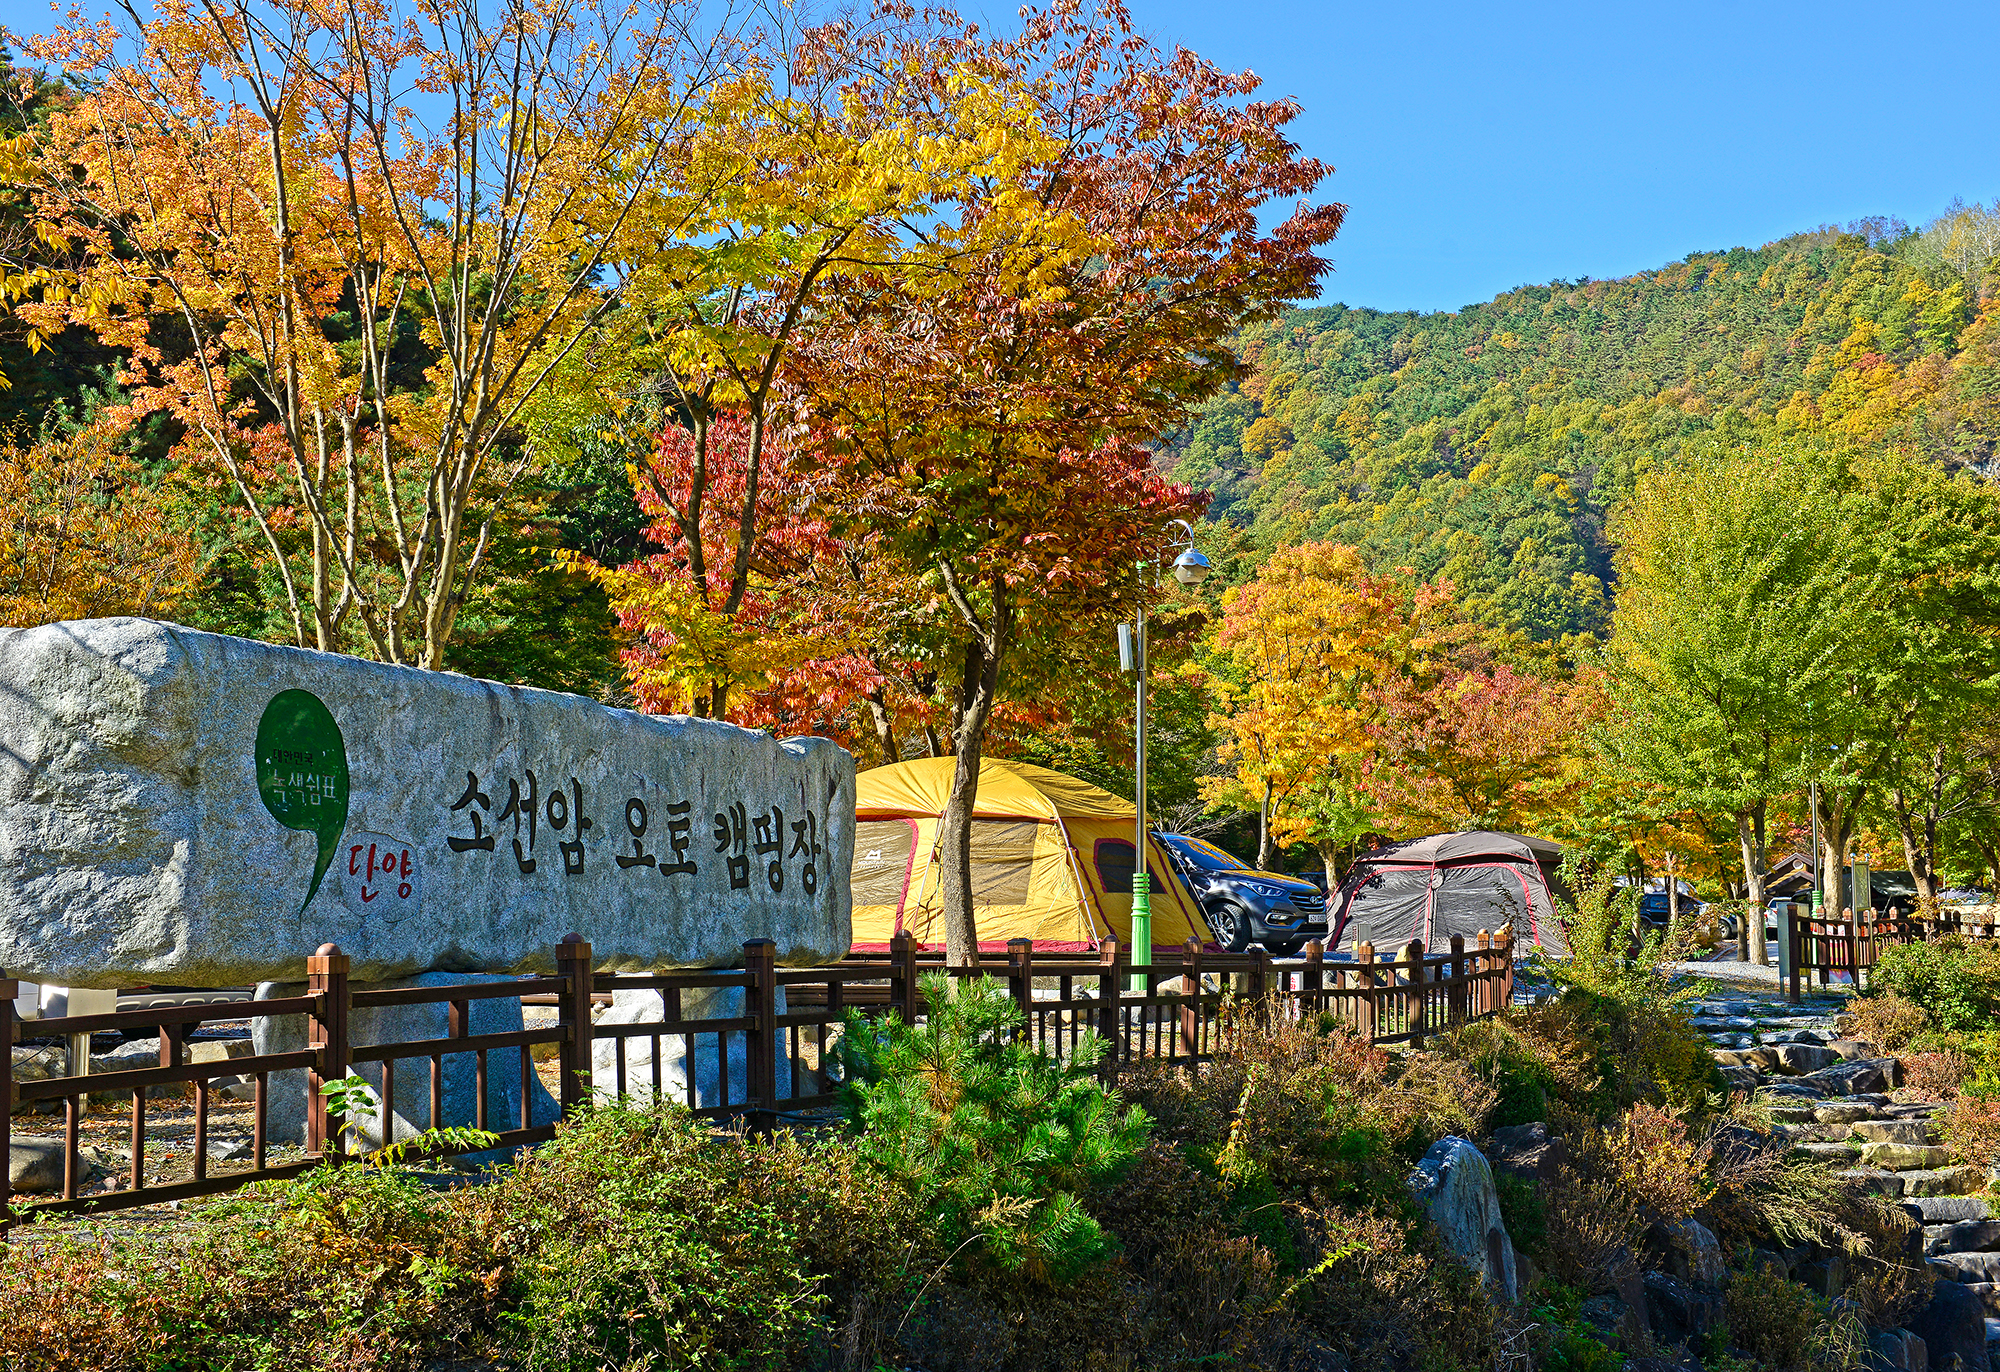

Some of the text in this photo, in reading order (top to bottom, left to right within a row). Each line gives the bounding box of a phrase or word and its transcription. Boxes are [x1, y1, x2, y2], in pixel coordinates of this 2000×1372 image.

[273, 748, 314, 767] 대한민국
[272, 768, 336, 806] 녹색쉼표
[447, 769, 821, 895] 소선암 오토 캠핑장
[349, 843, 413, 903] 단양
